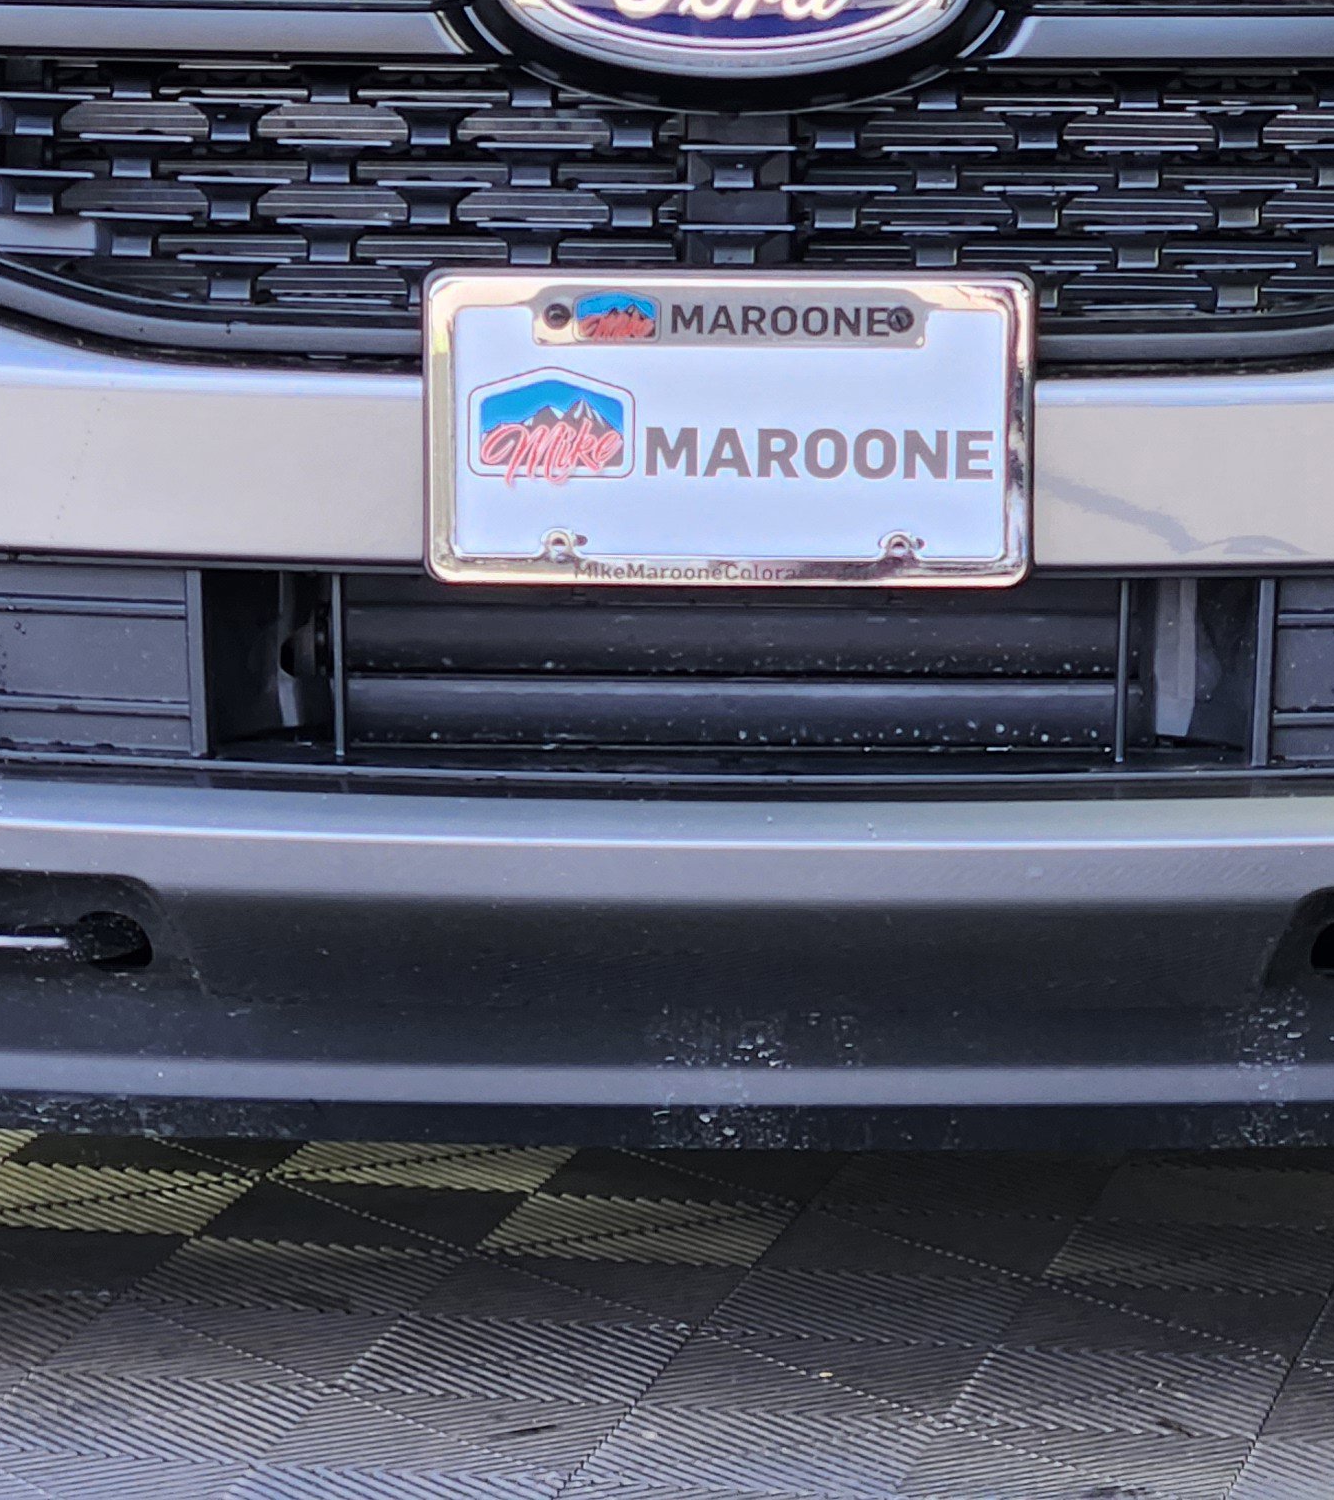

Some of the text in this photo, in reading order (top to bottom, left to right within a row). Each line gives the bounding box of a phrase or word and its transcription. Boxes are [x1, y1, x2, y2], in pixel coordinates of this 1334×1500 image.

[671, 304, 890, 337] MAROONE
[480, 417, 994, 488] Mike MAROONE
